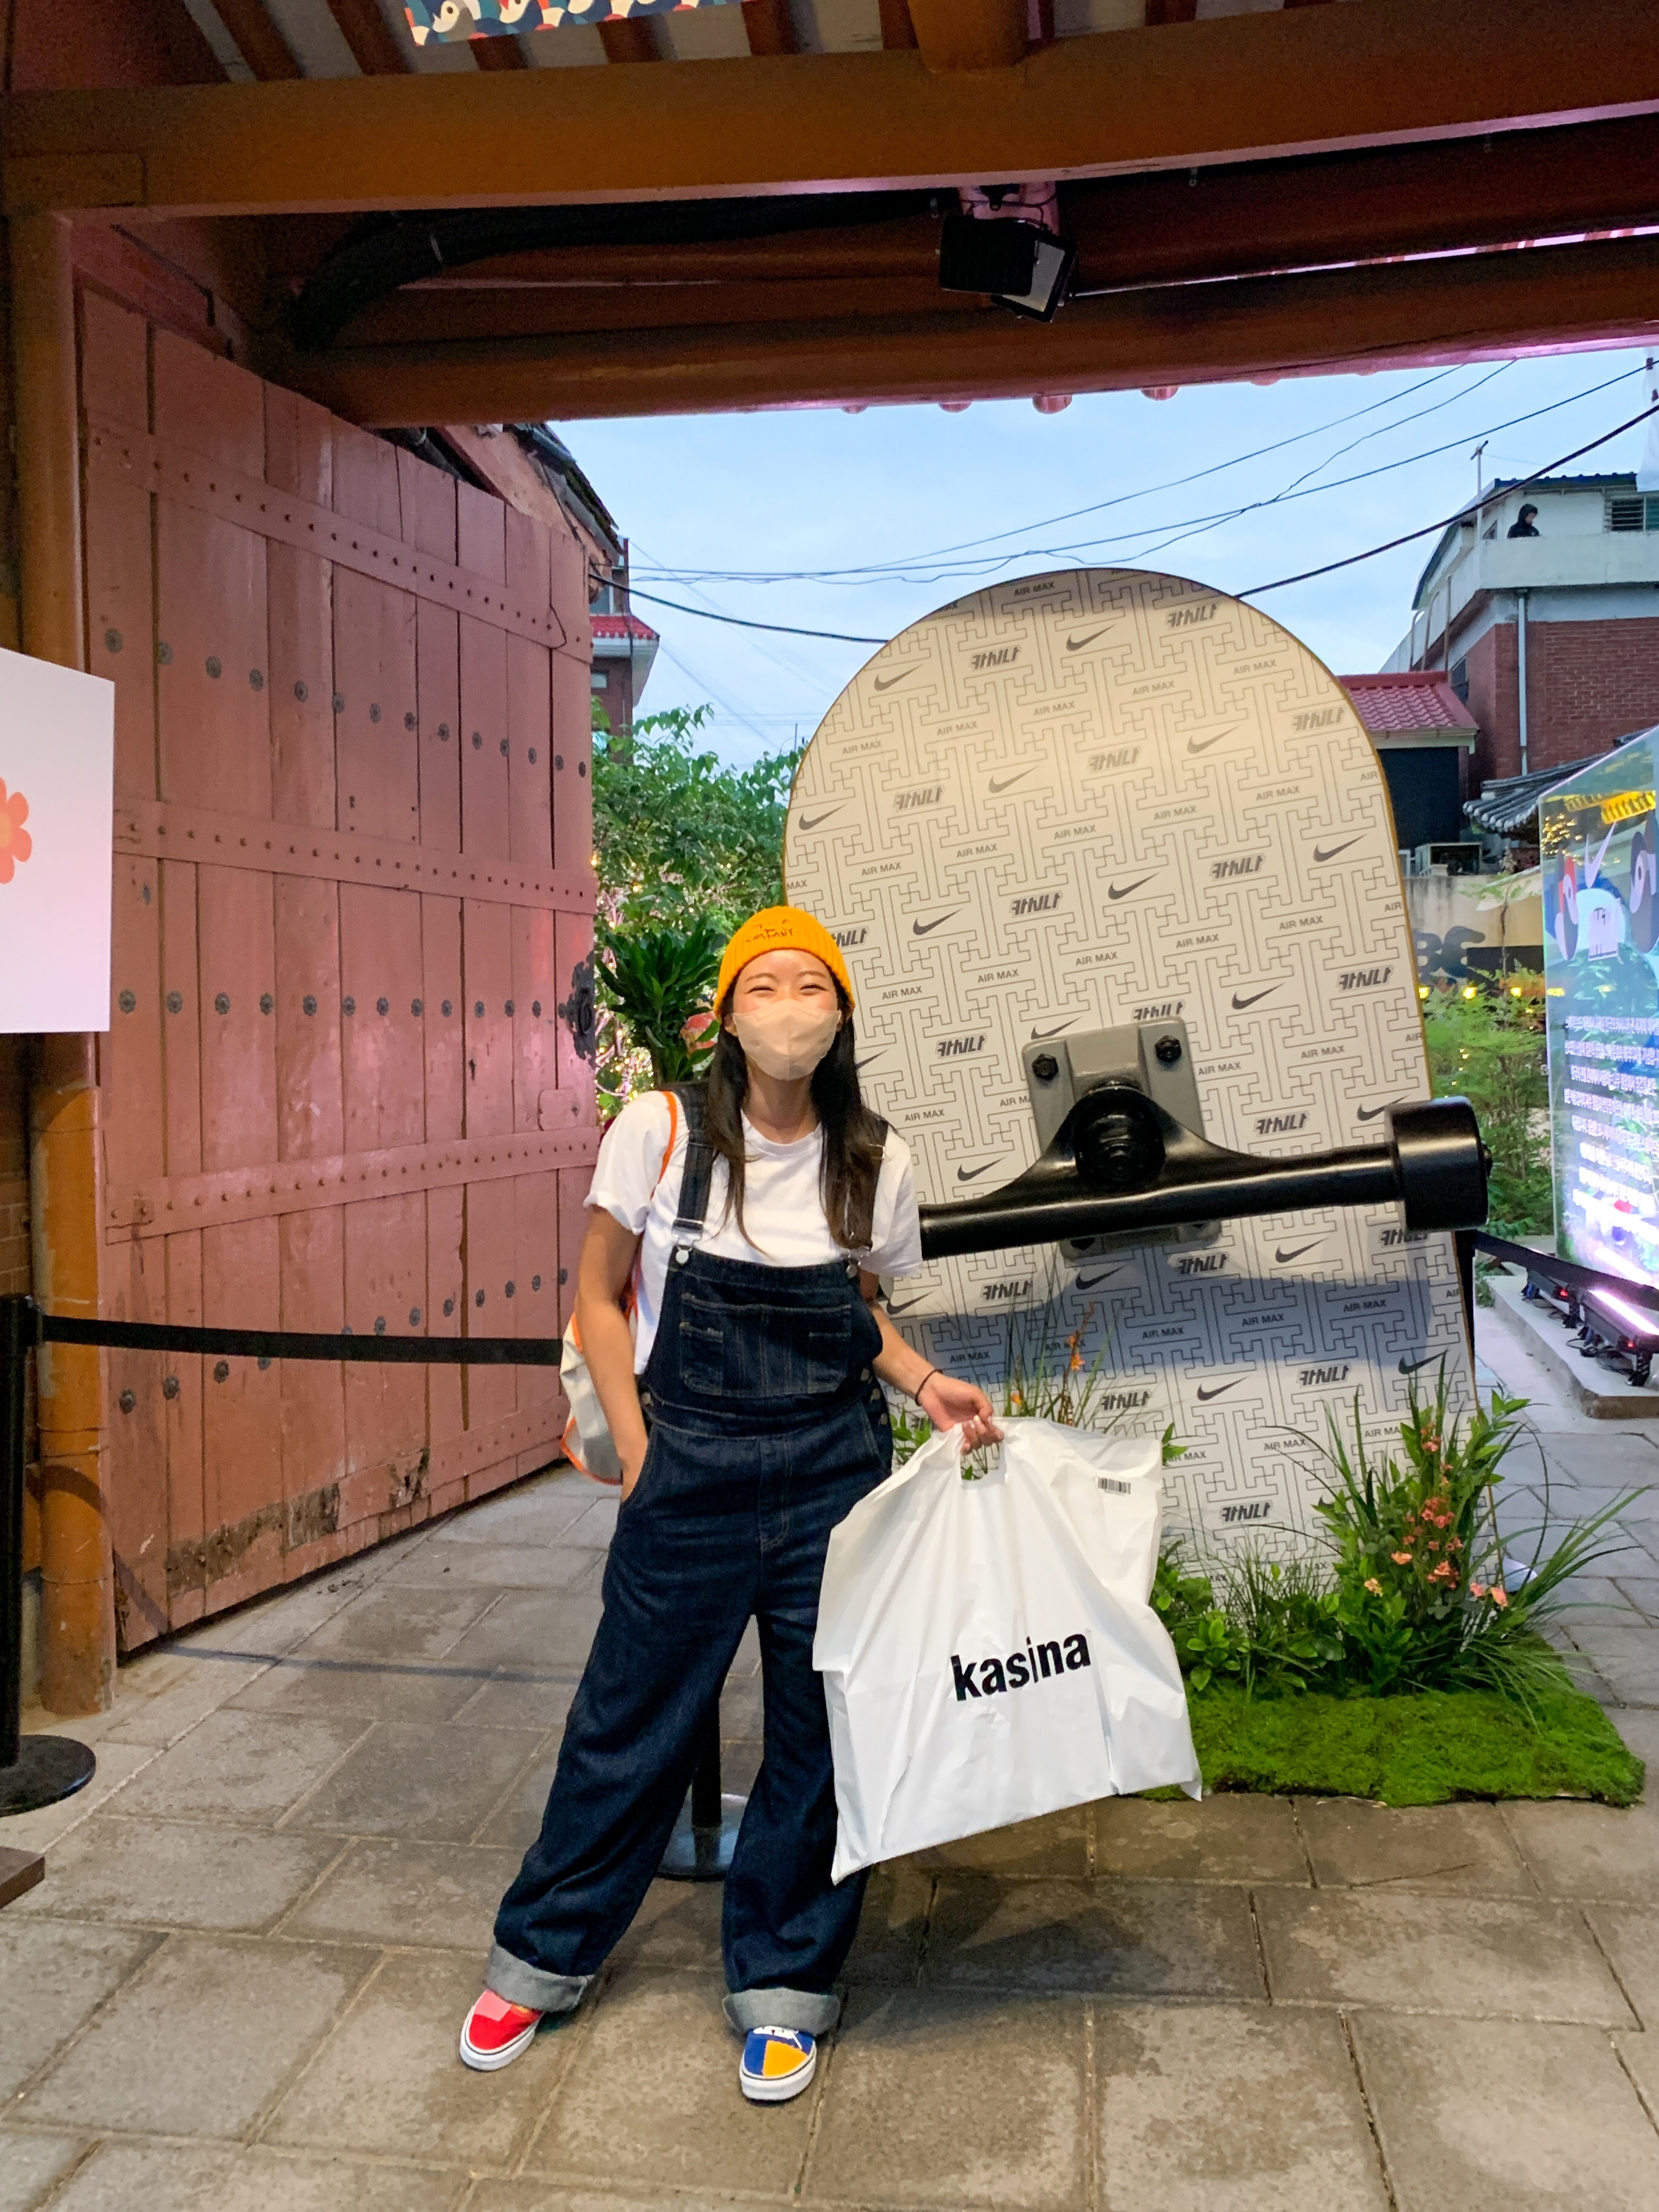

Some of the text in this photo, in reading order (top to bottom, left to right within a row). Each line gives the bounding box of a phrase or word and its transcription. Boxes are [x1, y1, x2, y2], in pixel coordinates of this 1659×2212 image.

[1014, 581, 1055, 596] AIR MAX
[1233, 659, 1277, 675] AIR MAX
[1132, 680, 1175, 696] AIR MAX
[1033, 700, 1075, 717] AIR MAX
[936, 721, 978, 736] AIR MAX
[842, 740, 882, 755] AIR MAX
[1360, 771, 1378, 782] AIR
[1256, 785, 1300, 801] AIR MAX
[1154, 805, 1197, 821] AIR MAX
[1053, 824, 1096, 840] AIR MAX
[956, 843, 998, 858] AIR MAX
[861, 861, 902, 877] AIR MAX
[787, 880, 808, 890] MAX
[1384, 901, 1402, 912] AIR
[1279, 915, 1324, 930] AIR MAX
[1175, 933, 1219, 949] AIR MAX
[1075, 951, 1118, 966] AIR MAX
[977, 968, 1019, 983] AIR MAX
[882, 985, 923, 1000] AIR MAX
[1301, 1044, 1345, 1060] AIR MAX
[1198, 1061, 1241, 1076] AIR MAX
[1000, 1098, 1016, 1107] AIR
[904, 1108, 945, 1122] AIR MAX
[1343, 1299, 1387, 1312] AIR MAX
[1242, 1313, 1285, 1327] AIR MAX
[1142, 1326, 1184, 1340] AIR MAX
[950, 1351, 990, 1363] AIR MAX
[1364, 1426, 1401, 1438] AIR MA
[1264, 1439, 1306, 1451] AIR MAX
[1184, 1450, 1206, 1460] MAX
[950, 1634, 1092, 1702] kasina
